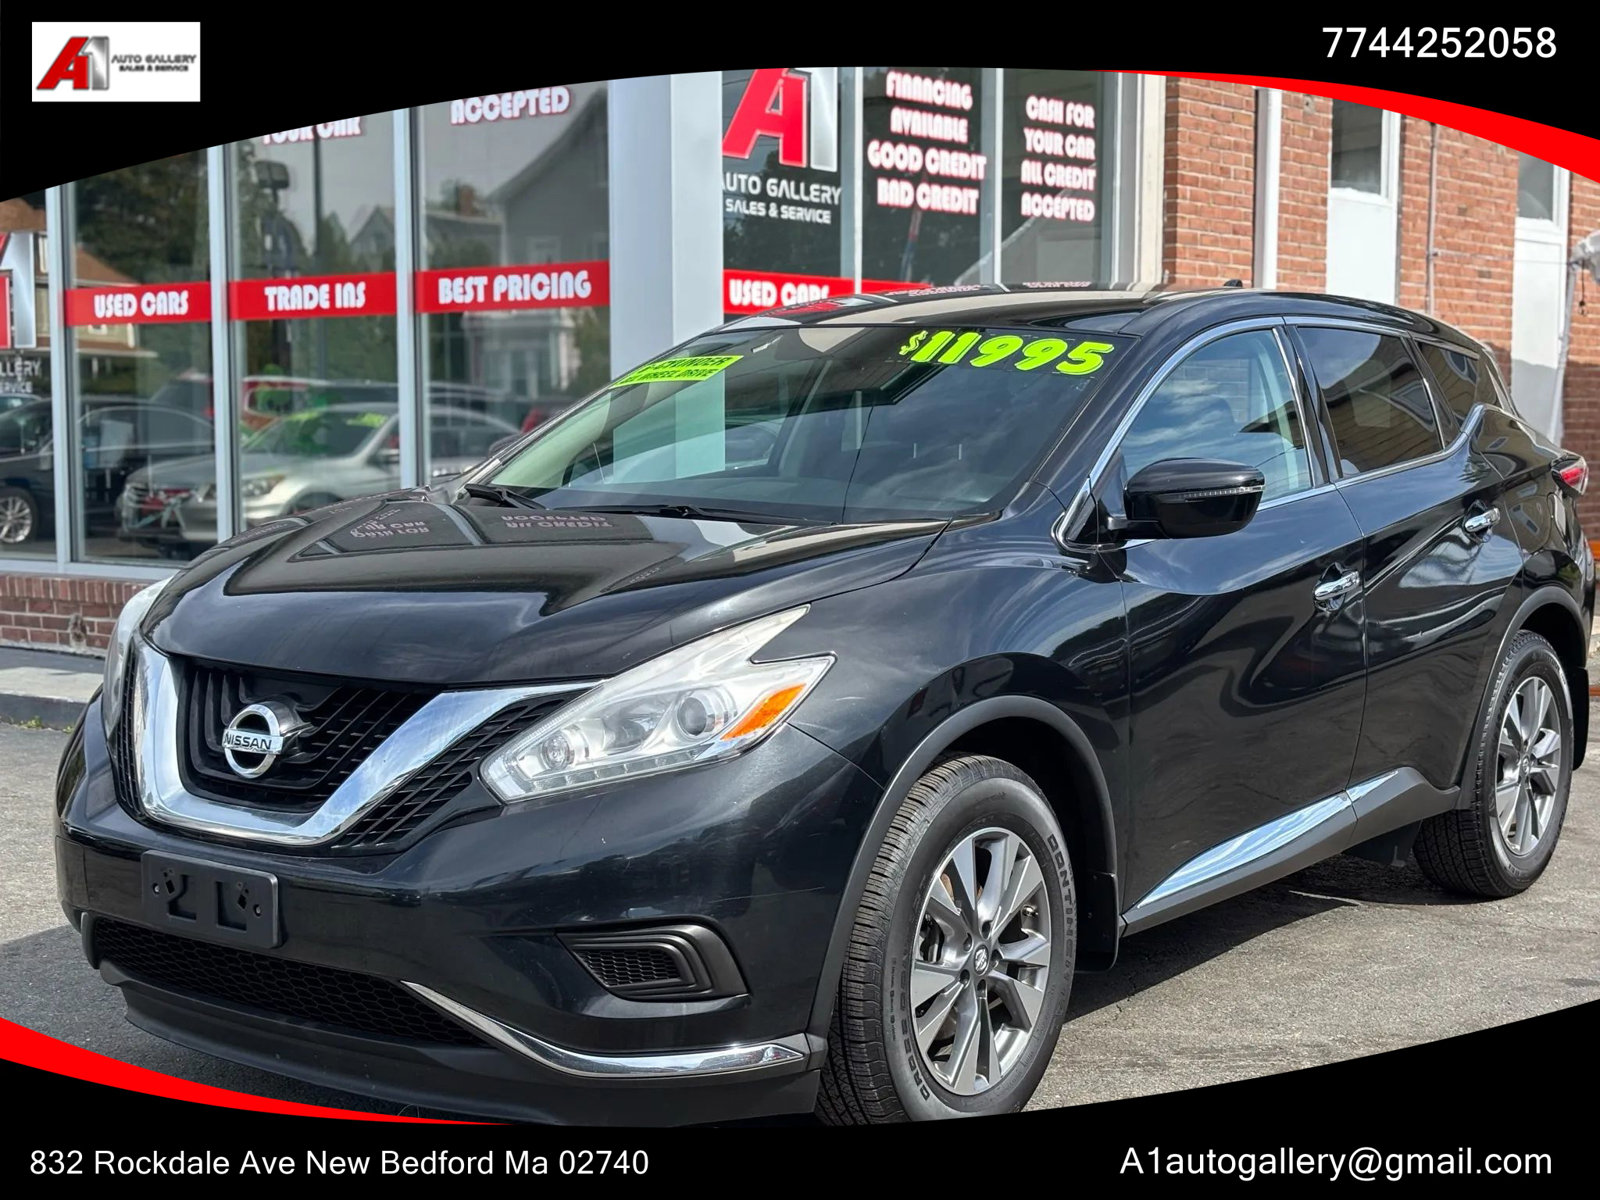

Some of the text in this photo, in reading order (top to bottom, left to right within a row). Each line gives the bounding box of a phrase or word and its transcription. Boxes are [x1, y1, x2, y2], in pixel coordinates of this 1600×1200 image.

[450, 86, 571, 125] ACCEPTED
[886, 70, 973, 110] FINANCING
[890, 106, 968, 143] AVAILABLE
[1026, 95, 1096, 129] CASH FOR
[867, 139, 987, 180] GOOD CREDIT
[1023, 127, 1096, 160] YOUR CAR
[766, 178, 842, 205] GALLERY
[1021, 159, 1097, 191] ALL CREDIT
[725, 198, 832, 224] SALES & SERVICE
[877, 177, 979, 214] BAD CREDIT
[1021, 192, 1096, 222] ACCEPTED
[264, 281, 366, 312] TRADE INS
[438, 270, 592, 304] BEST PRICING
[729, 279, 778, 307] USED
[93, 290, 189, 318] USED CARS
[899, 330, 1115, 375] $11995
[223, 732, 272, 749] NISSAN
